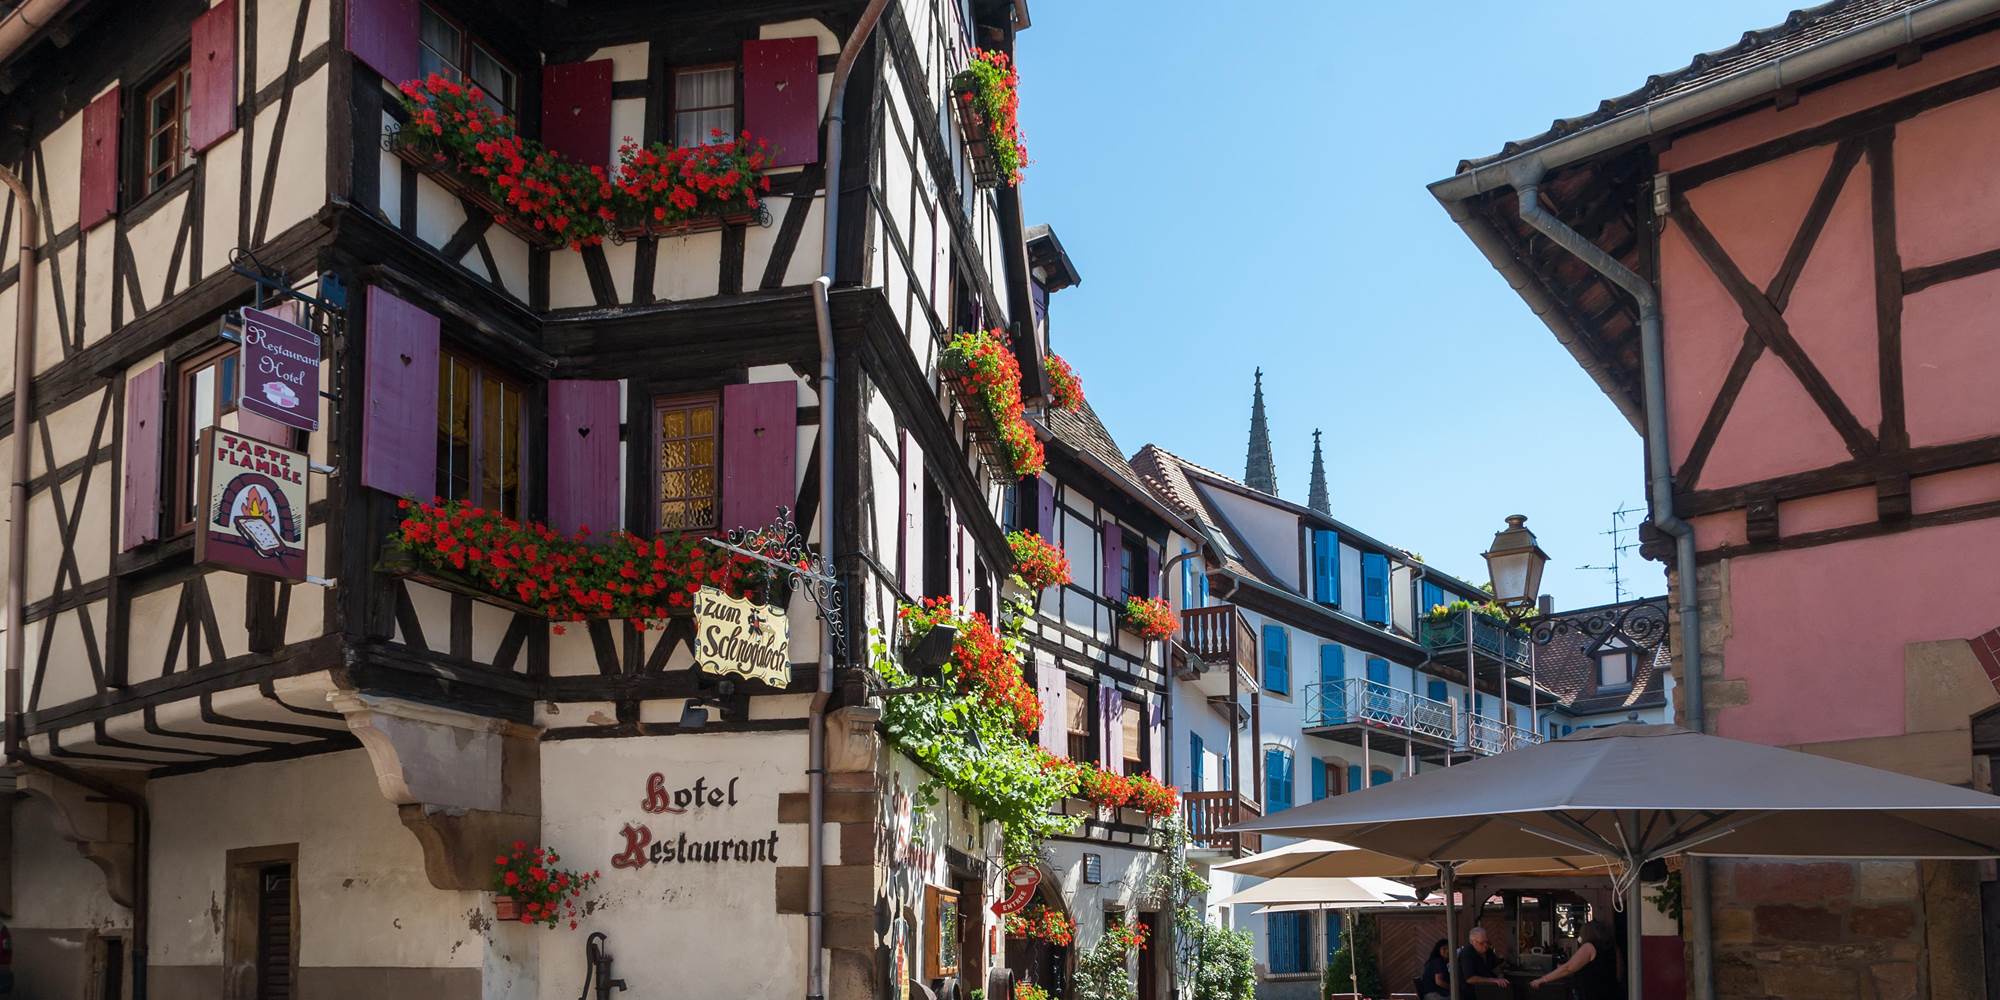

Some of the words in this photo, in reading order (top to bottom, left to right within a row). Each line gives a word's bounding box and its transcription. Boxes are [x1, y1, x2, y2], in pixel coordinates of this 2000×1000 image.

[246, 325, 320, 367] Restaurant
[258, 355, 305, 386] Hotel
[222, 435, 291, 467] TARTE
[641, 772, 739, 814] Hotel
[611, 821, 779, 870] Restaurant
